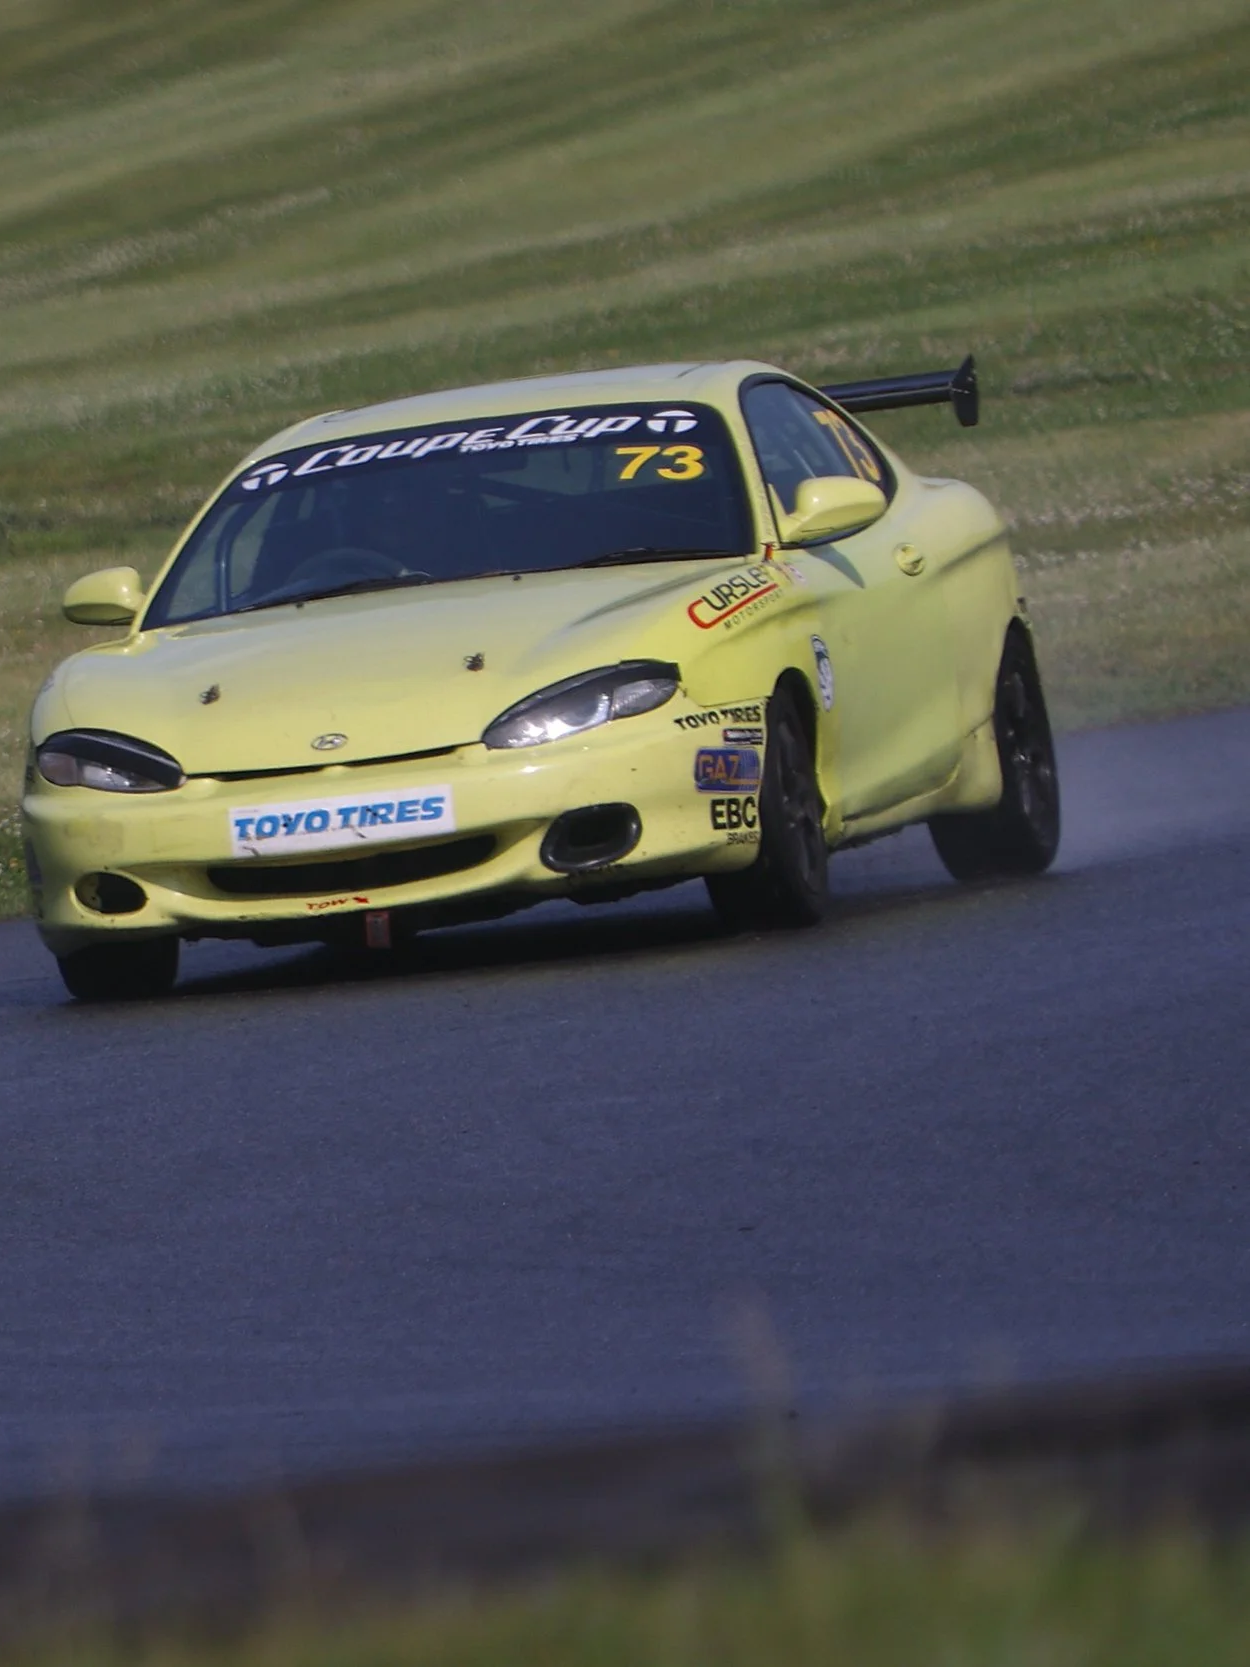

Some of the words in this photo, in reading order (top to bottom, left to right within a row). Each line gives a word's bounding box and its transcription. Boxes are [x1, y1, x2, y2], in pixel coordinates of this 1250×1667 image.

[459, 440, 515, 454] TOYO
[517, 433, 579, 447] TIRES
[614, 444, 706, 481] 73
[674, 710, 720, 731] TOYO
[719, 705, 762, 724] TIRES
[698, 753, 741, 781] GAZ
[234, 808, 330, 841] TOYO
[337, 796, 446, 829] TIRES
[710, 796, 757, 831] EBC
[307, 898, 348, 911] TOW
